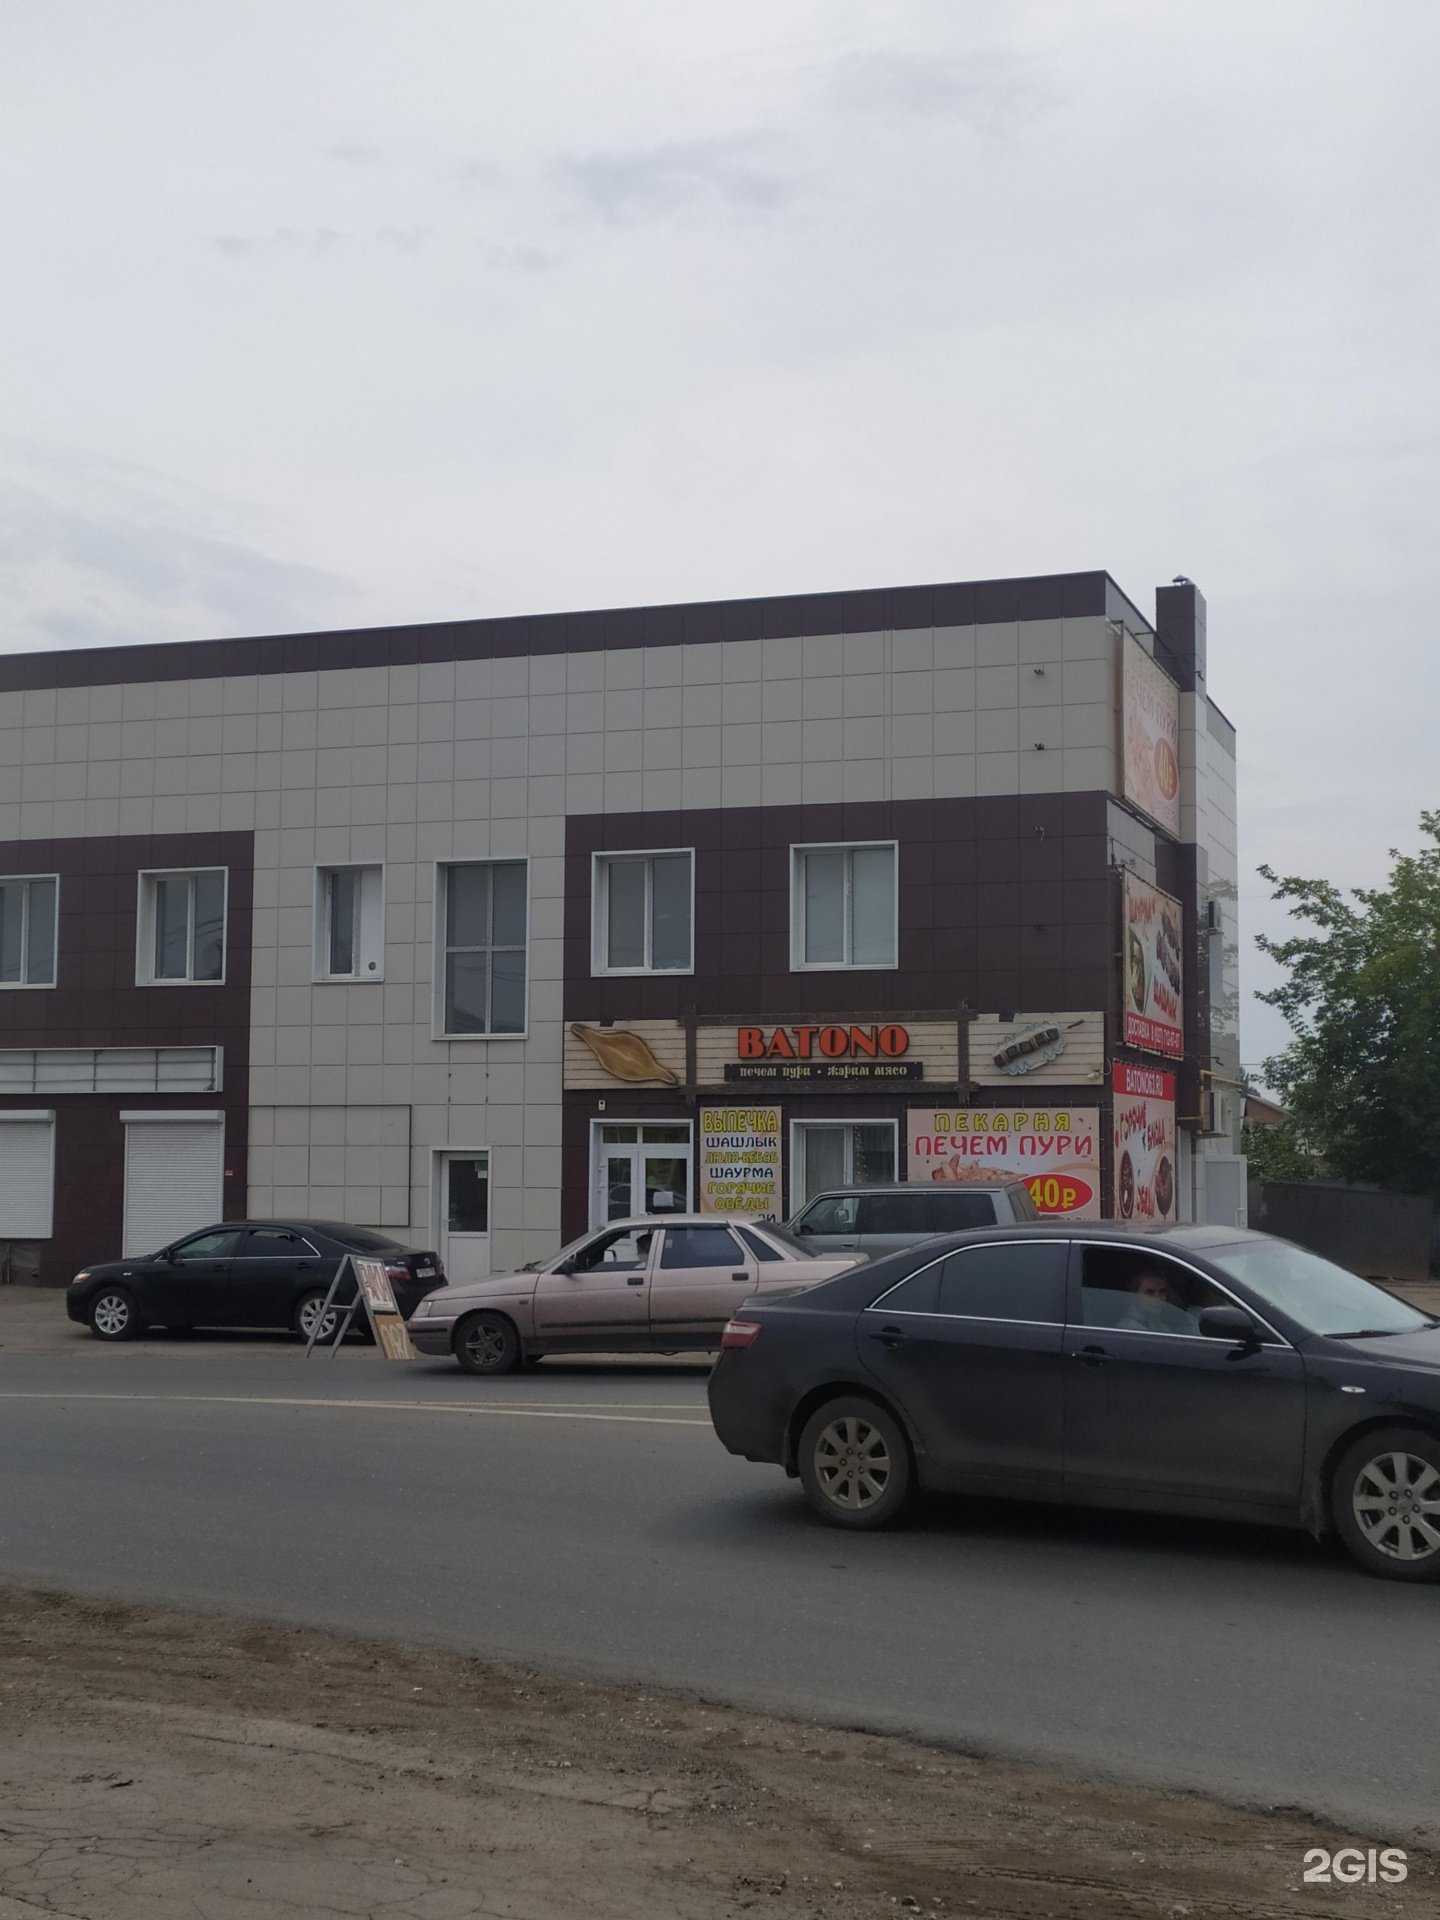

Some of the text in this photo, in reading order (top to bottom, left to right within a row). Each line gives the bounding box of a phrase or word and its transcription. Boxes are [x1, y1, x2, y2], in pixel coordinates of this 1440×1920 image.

[737, 1024, 910, 1059] BATONO
[739, 1066, 908, 1079] печем пури жарим мясо
[703, 1110, 777, 1133] ВЫПЕЧКА
[933, 1112, 1072, 1133] ПЕКАРНЯ
[706, 1137, 777, 1148] ШАШЛЫК
[914, 1135, 1092, 1156] ПЕЧЕМ ПУРИ
[709, 1167, 774, 1178] ШАУРМА
[707, 1181, 777, 1195] ГОРЯЧИЕ
[714, 1196, 769, 1211] ОБЕДЫ
